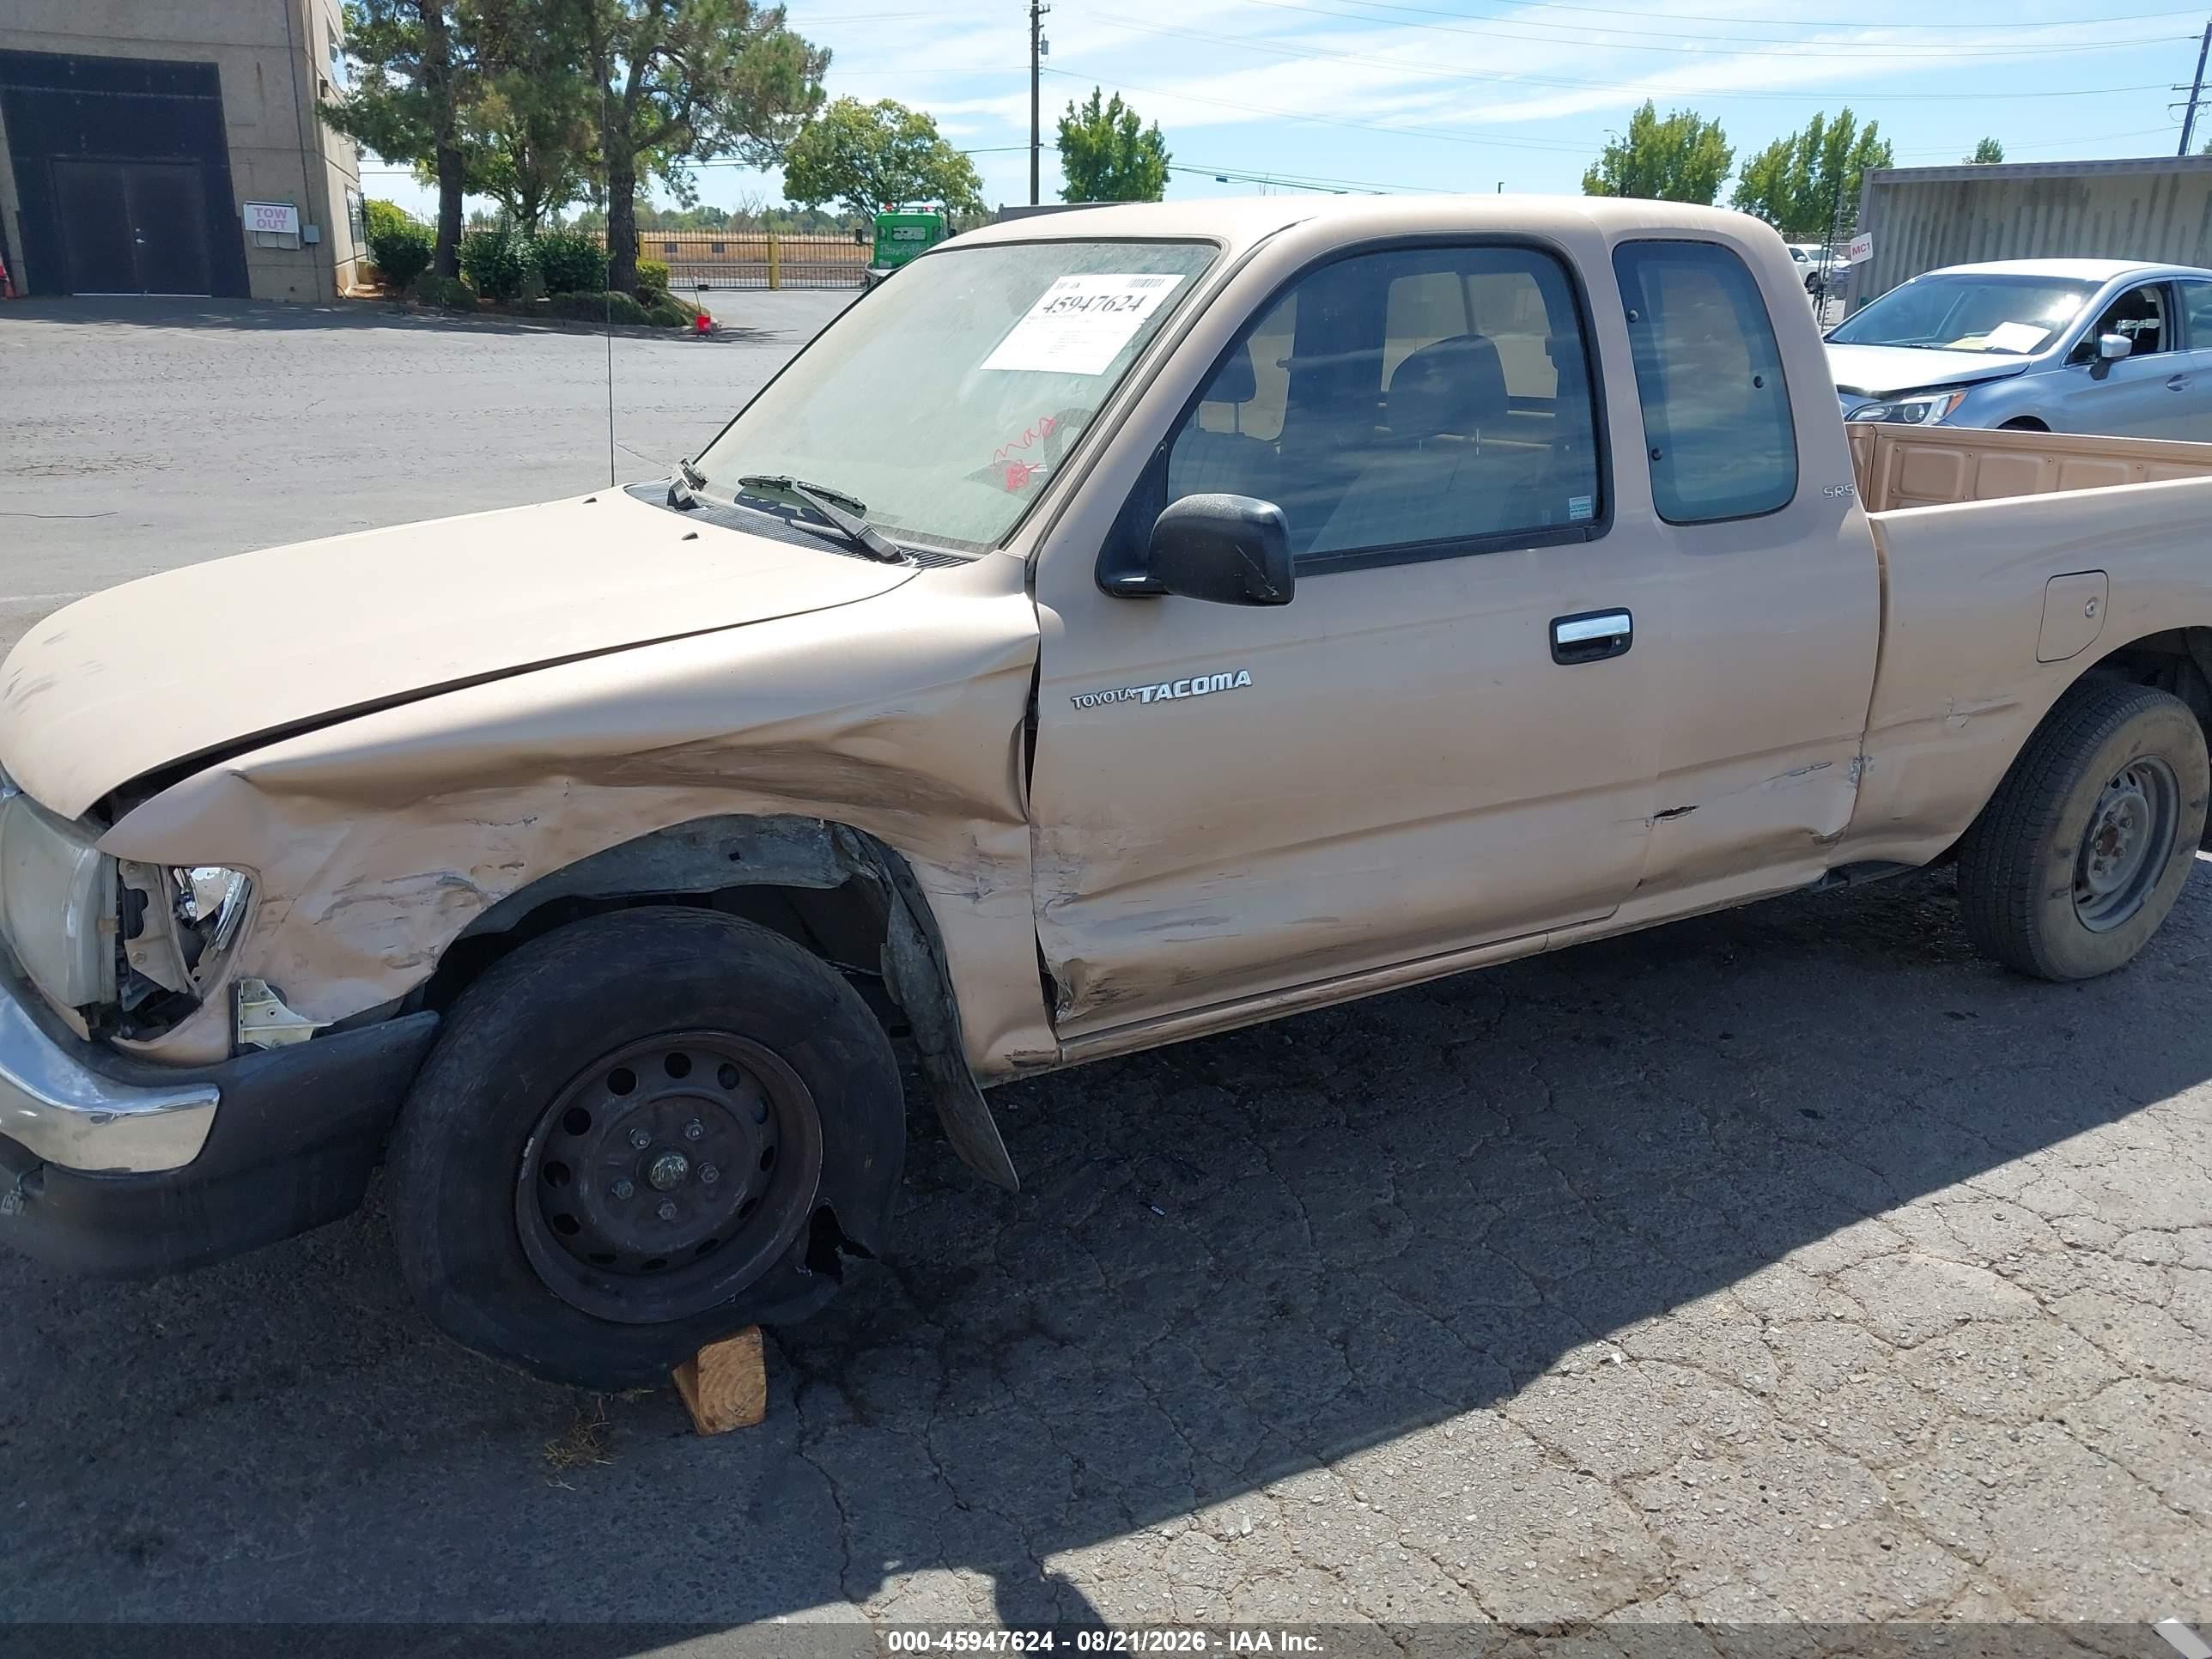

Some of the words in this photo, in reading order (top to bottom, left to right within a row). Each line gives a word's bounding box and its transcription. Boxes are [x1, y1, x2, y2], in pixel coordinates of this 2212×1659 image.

[254, 208, 288, 219] TOW
[257, 219, 287, 230] OUT
[1852, 241, 1870, 256] MC1
[1042, 295, 1147, 313] 45947624
[1823, 483, 1855, 499] SRS
[1072, 687, 1135, 709] TOYOTA
[1133, 669, 1253, 704] TACOMA
